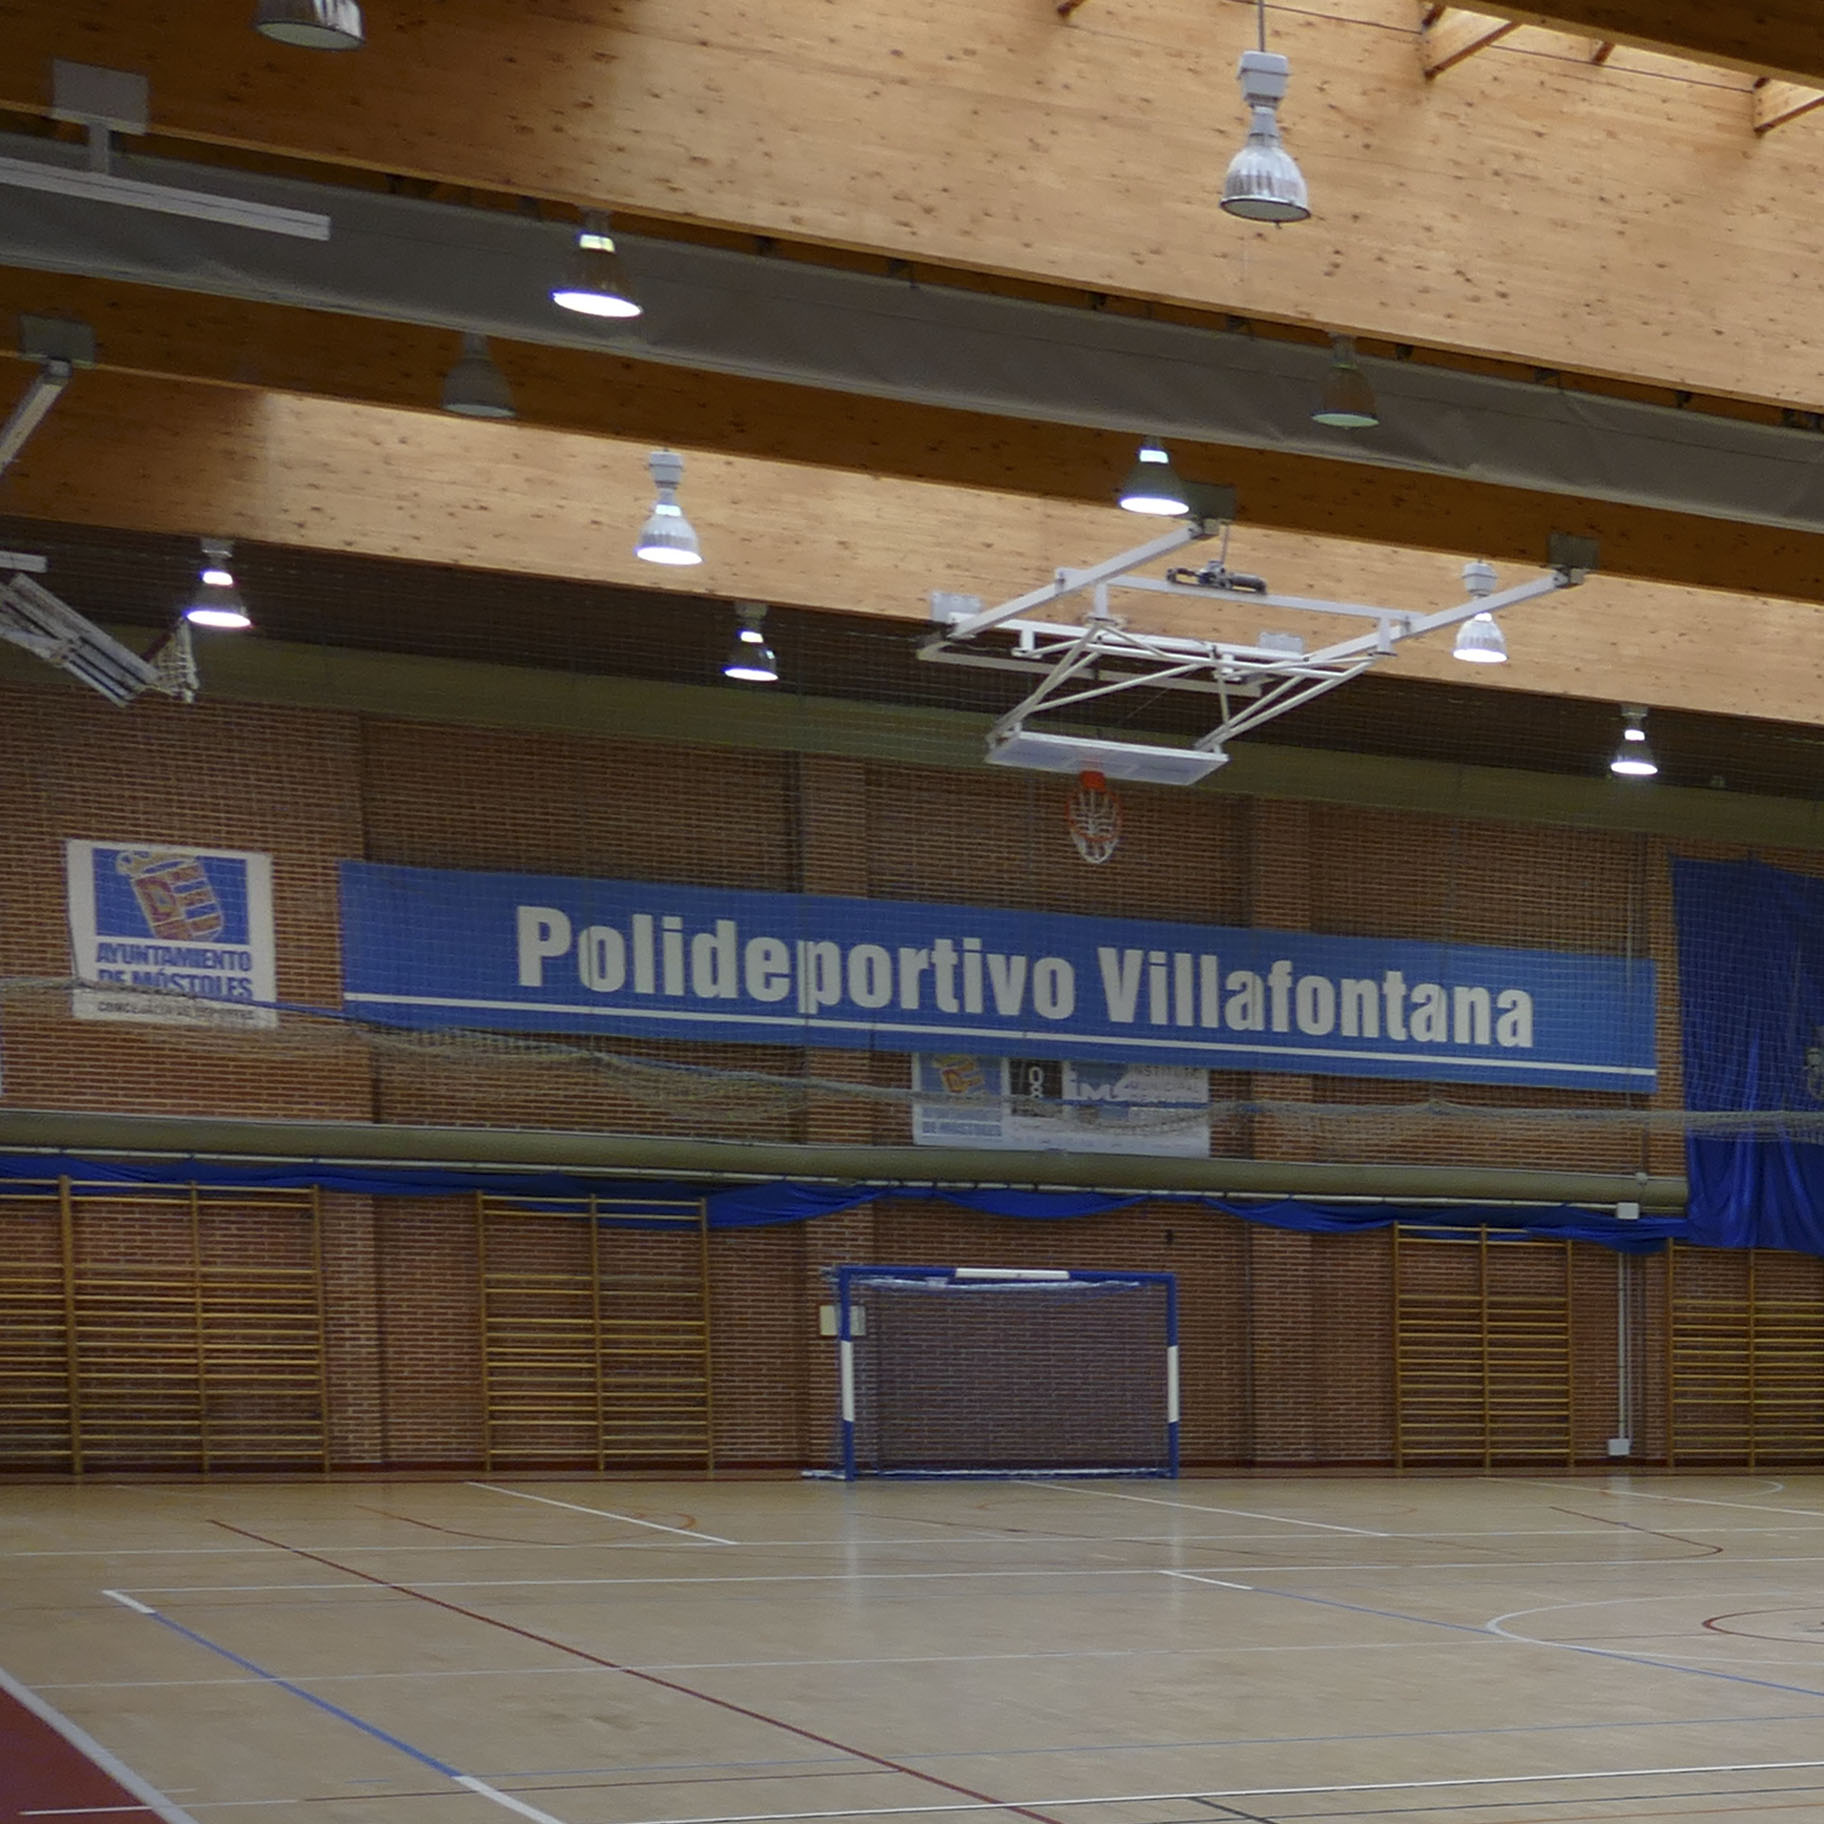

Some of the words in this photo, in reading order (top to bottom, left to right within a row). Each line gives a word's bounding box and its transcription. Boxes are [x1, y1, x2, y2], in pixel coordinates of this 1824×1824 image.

[96, 942, 252, 972] AYUNTAMIENTO
[132, 968, 254, 1000] MÓSTOLES
[517, 905, 1075, 1020] Polideportivo
[1098, 947, 1534, 1047] Villafontana
